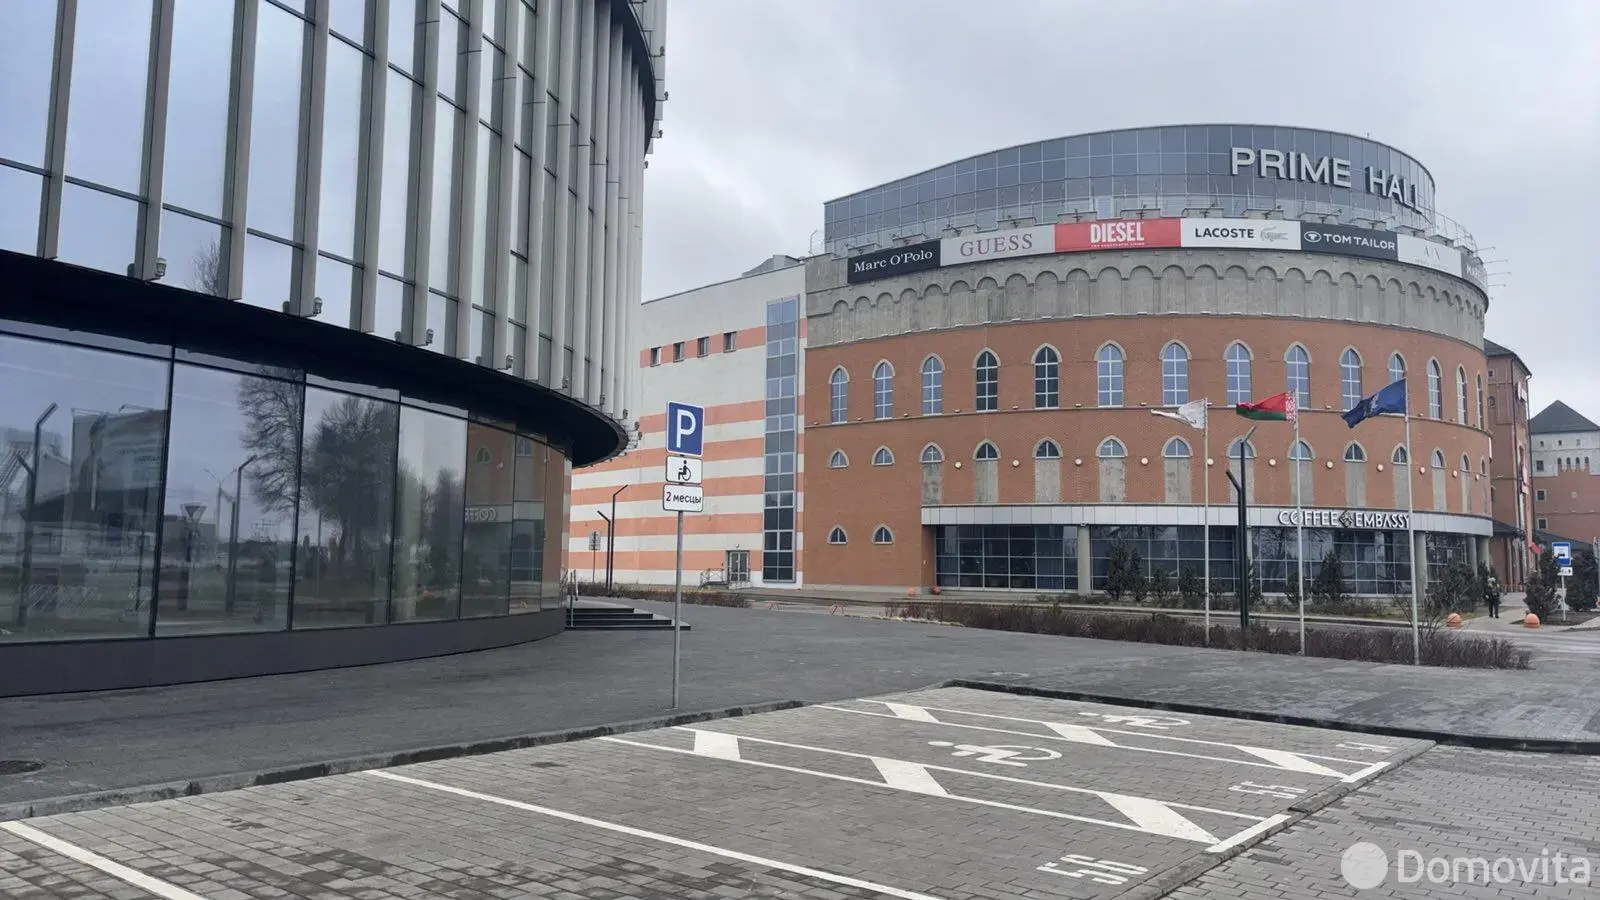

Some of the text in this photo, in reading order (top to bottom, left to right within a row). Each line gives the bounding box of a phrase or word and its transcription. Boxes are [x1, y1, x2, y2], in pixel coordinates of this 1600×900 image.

[1231, 147, 1421, 213] PRIME HALL
[1090, 221, 1144, 243] DIESEL
[1195, 228, 1255, 239] LACOSTE
[1323, 233, 1395, 251] TOM TAILOR
[960, 233, 1034, 258] GUESS
[854, 250, 933, 274] Marc O'Polo
[676, 409, 696, 448] P
[666, 491, 701, 504] 2 месцы
[1278, 510, 1410, 529] COFFEE EMBASSY
